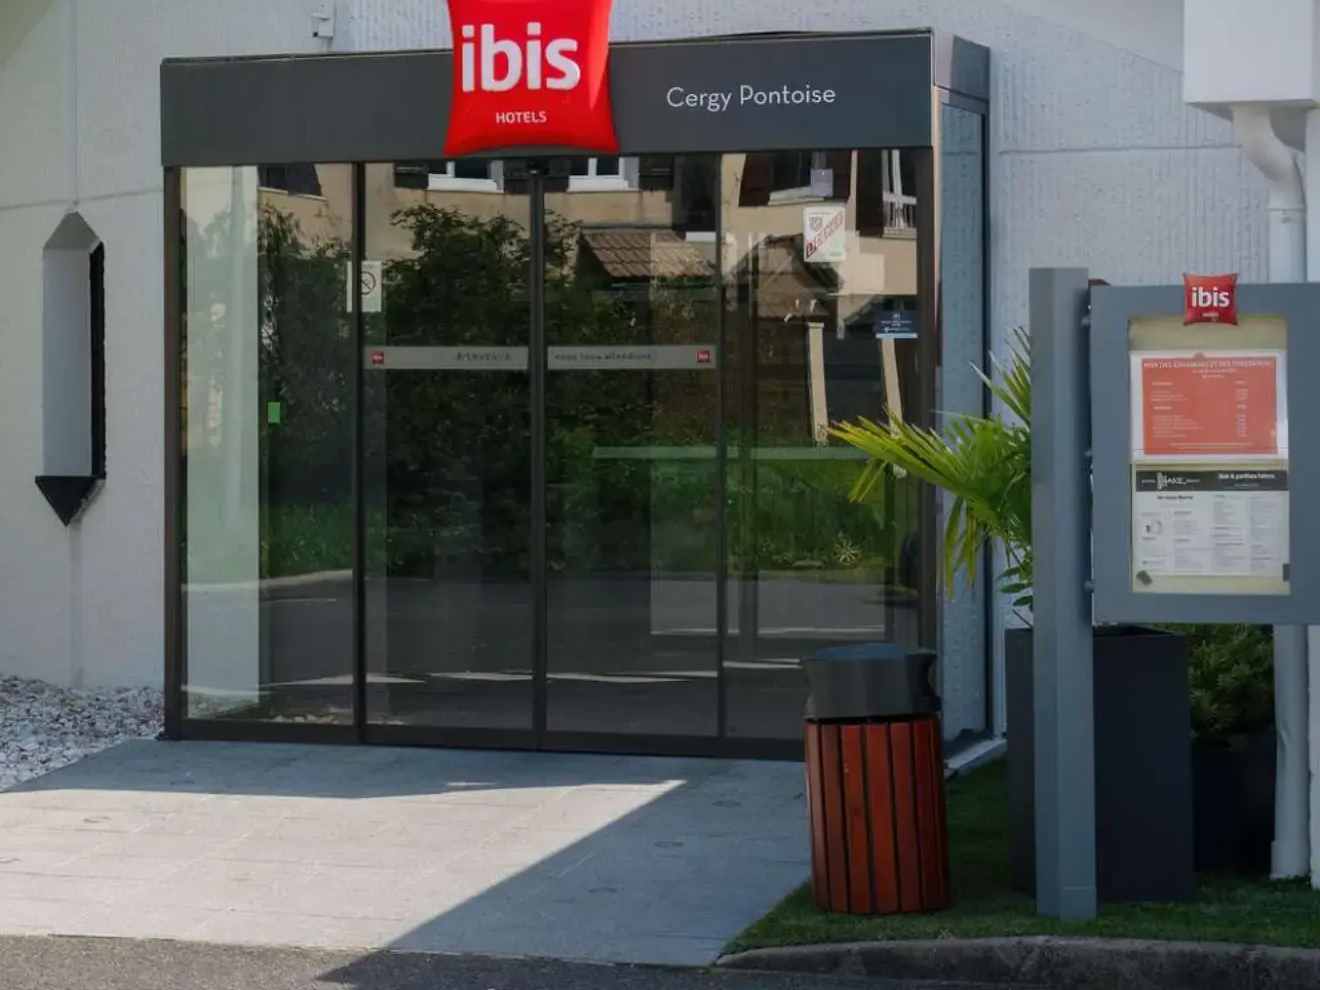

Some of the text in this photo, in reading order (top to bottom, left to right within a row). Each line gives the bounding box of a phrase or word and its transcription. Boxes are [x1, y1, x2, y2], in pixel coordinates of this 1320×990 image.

[461, 22, 581, 92] ibis
[666, 84, 836, 112] Cergy Pontoise
[495, 111, 547, 124] HOTELS
[1191, 286, 1230, 308] ibis
